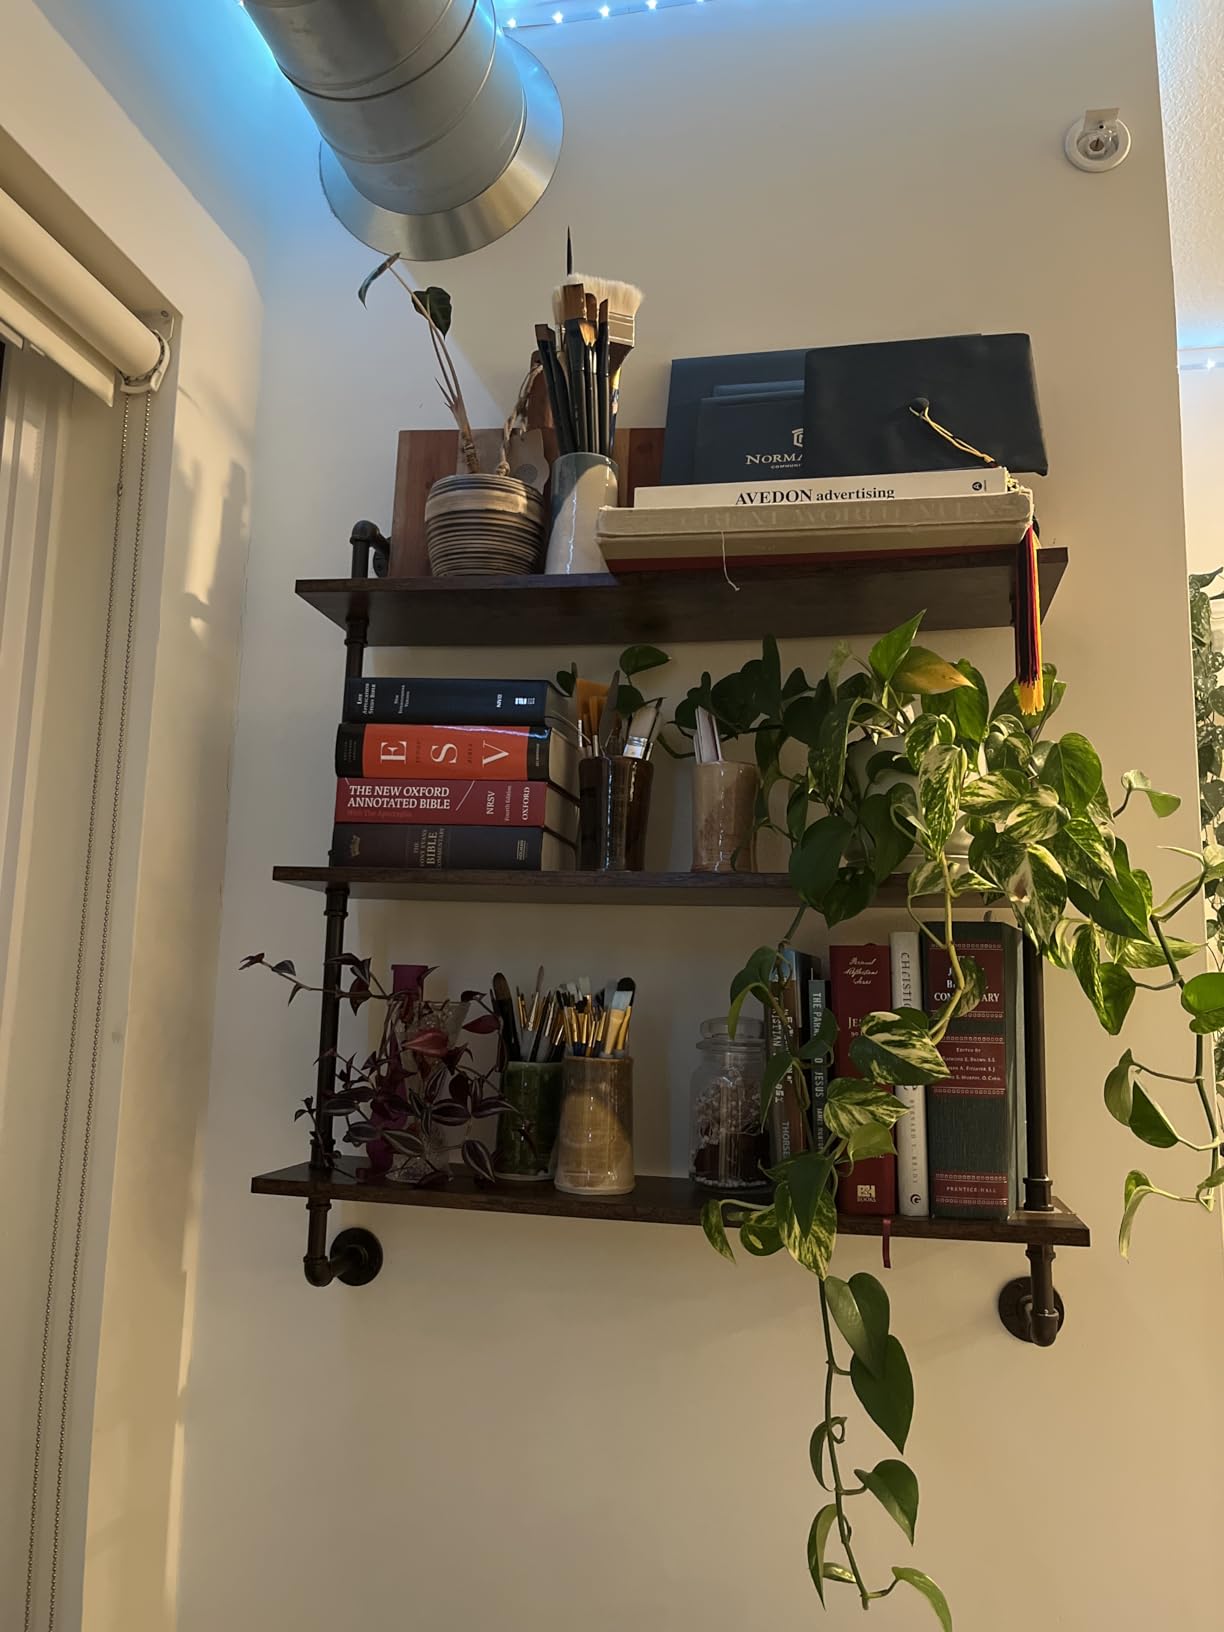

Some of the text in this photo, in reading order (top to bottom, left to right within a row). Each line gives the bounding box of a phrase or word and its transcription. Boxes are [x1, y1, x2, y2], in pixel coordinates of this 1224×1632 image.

[735, 487, 895, 505] AVEDON advertising
[349, 785, 450, 797] THE NEW OXFORD
[347, 797, 450, 809] ANNOTATED BIBLE
[486, 790, 496, 815] NRSV
[521, 786, 530, 821] OXFORD
[426, 831, 438, 865] BIBLE
[812, 992, 822, 1009] THE
[934, 992, 1000, 1002] COARY
[814, 1071, 824, 1098] JESUS
[782, 1120, 791, 1159] THORSE
